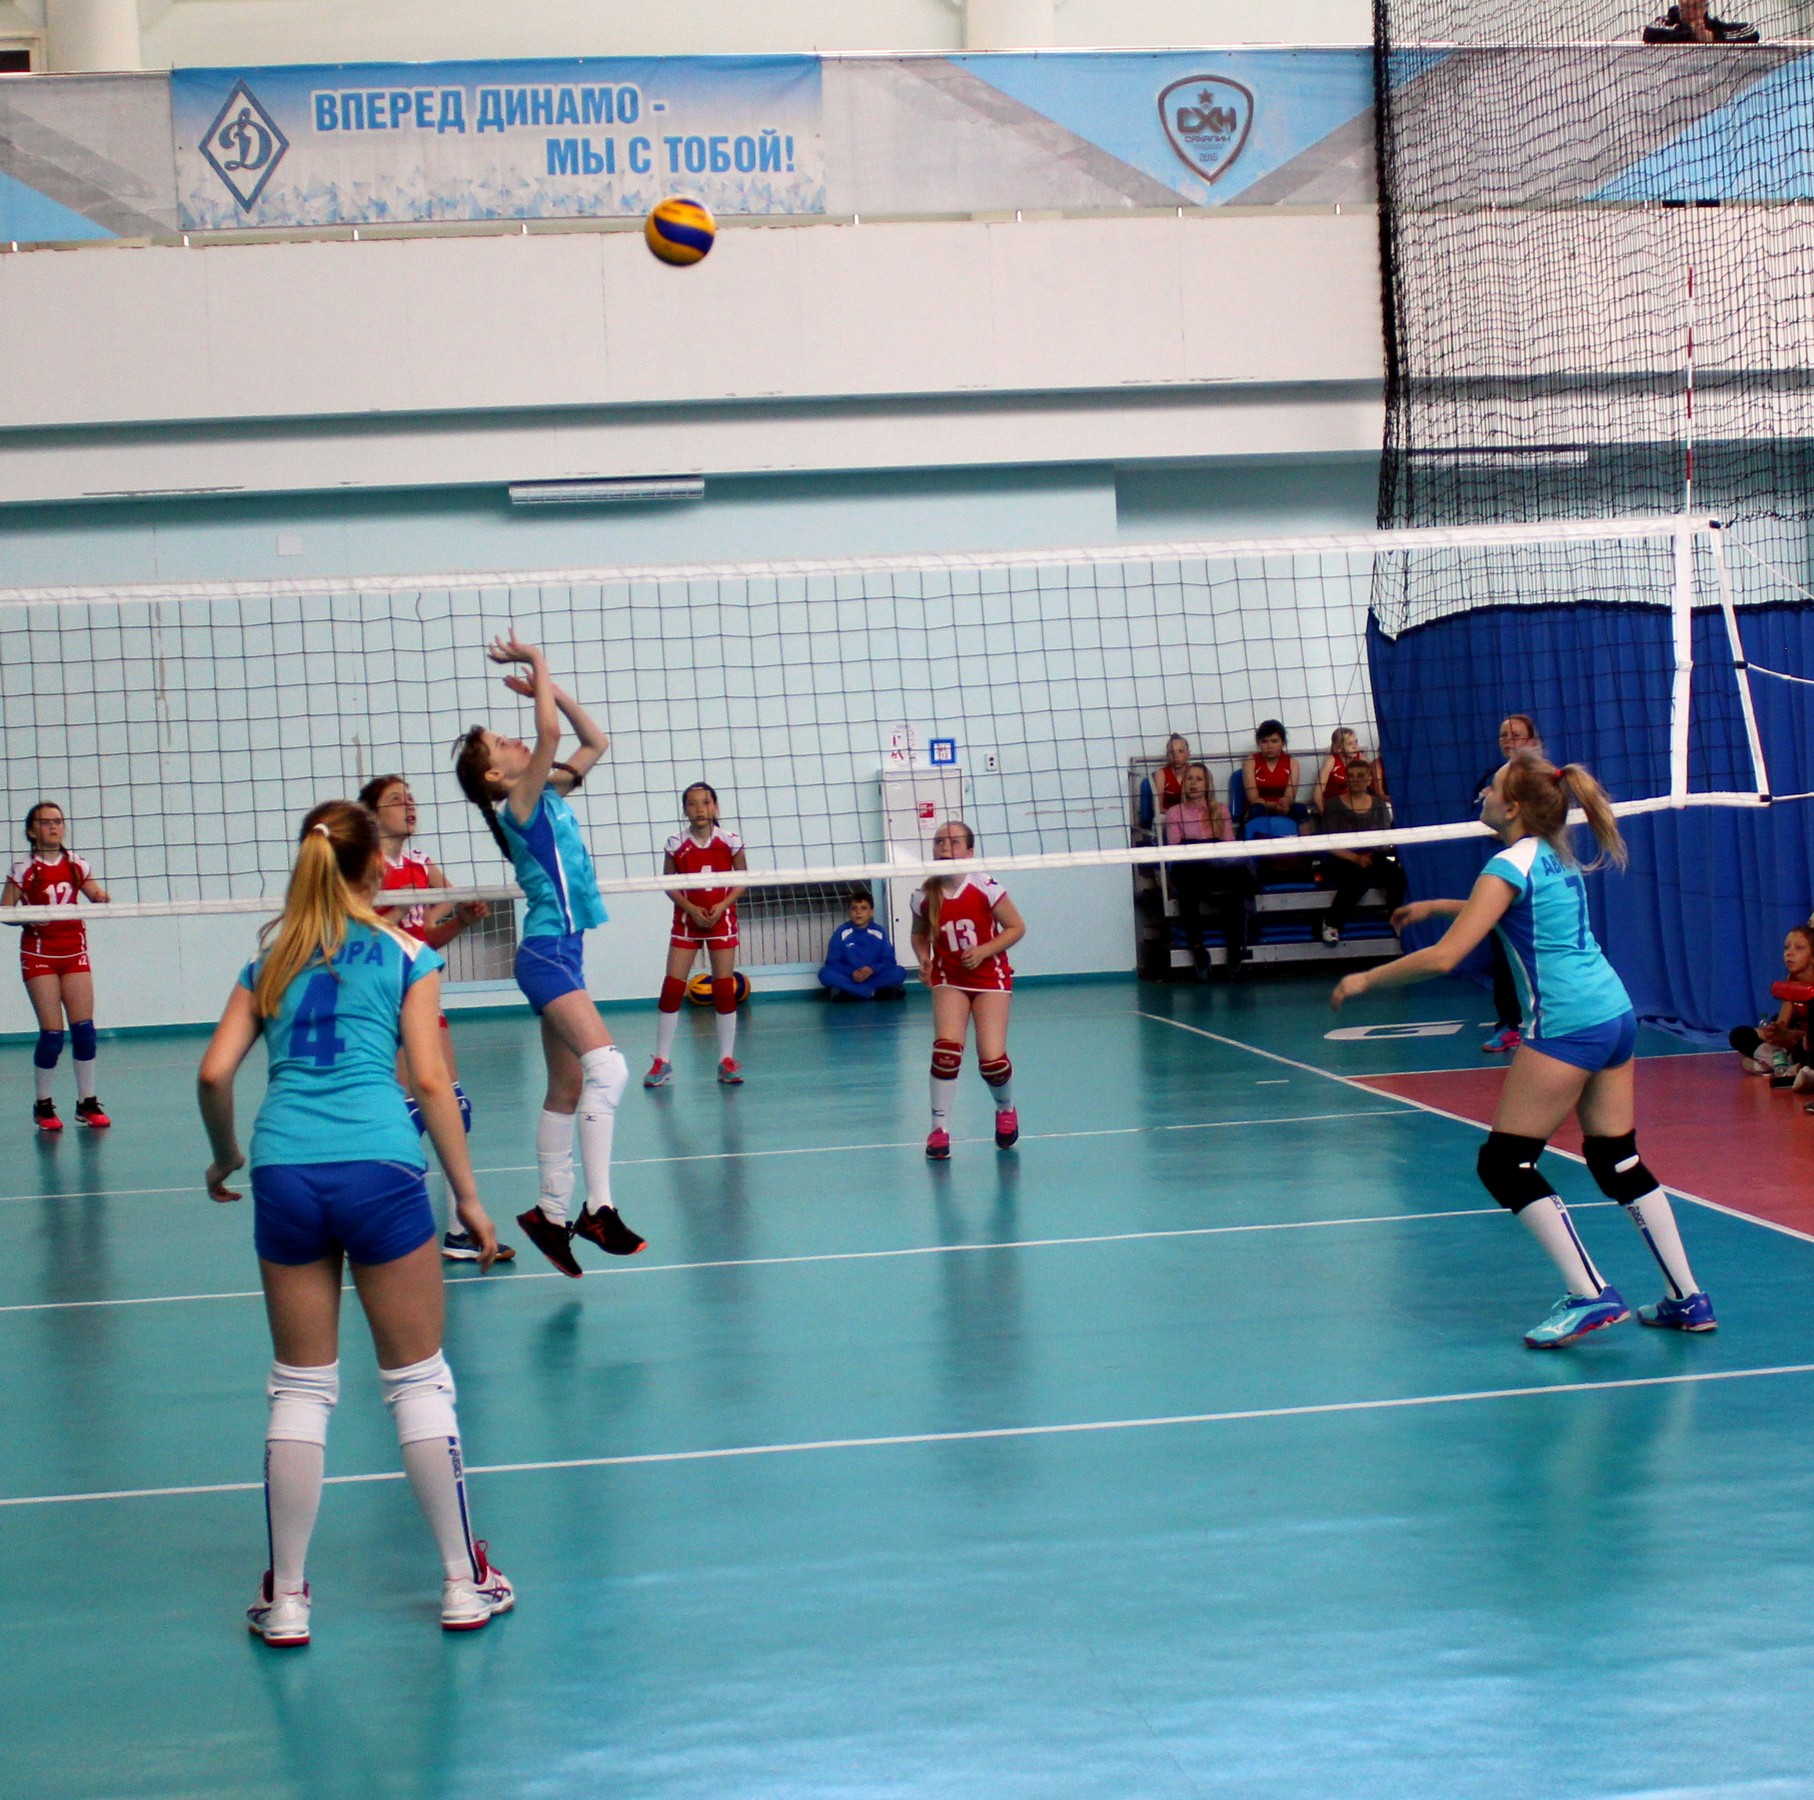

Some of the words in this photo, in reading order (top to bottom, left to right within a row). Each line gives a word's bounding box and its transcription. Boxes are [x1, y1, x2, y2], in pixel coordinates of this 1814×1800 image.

[315, 90, 465, 134] ВПЕРЕД
[477, 86, 639, 133] ДИНАМО
[546, 137, 616, 175] МЫ
[628, 136, 651, 174] С
[664, 128, 794, 174] ТОБОЙ!
[1541, 853, 1566, 877] АВ
[44, 882, 73, 905] 12
[1564, 875, 1586, 950] 7
[940, 918, 978, 952] 13
[288, 972, 346, 1067] 4
